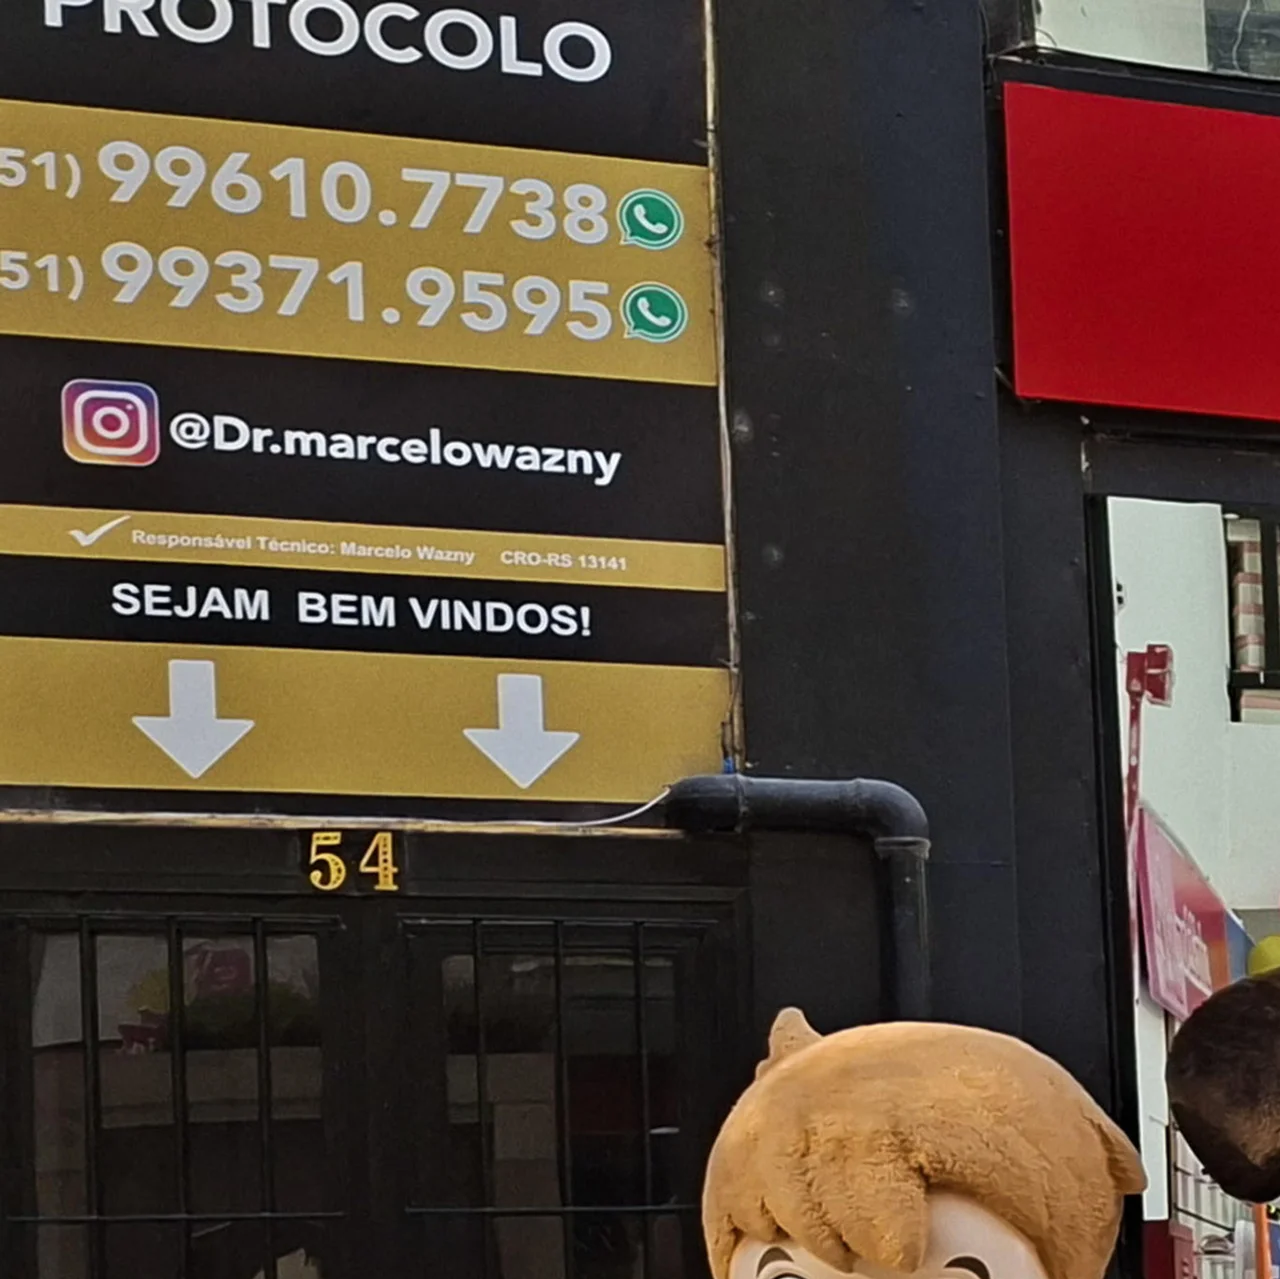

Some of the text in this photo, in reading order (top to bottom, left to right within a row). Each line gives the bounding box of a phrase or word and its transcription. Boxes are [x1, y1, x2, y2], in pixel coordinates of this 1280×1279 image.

[99, 141, 610, 245] 99610.7738
[101, 242, 612, 341] 99371.9595
[169, 411, 622, 486] @Dr.marcelowazny
[131, 528, 628, 572] Responsável Técnico: Marcelo Wazny CRO-RS 13141
[112, 583, 593, 637] SEJAM BEM VINDOS!
[309, 832, 398, 891] 54
